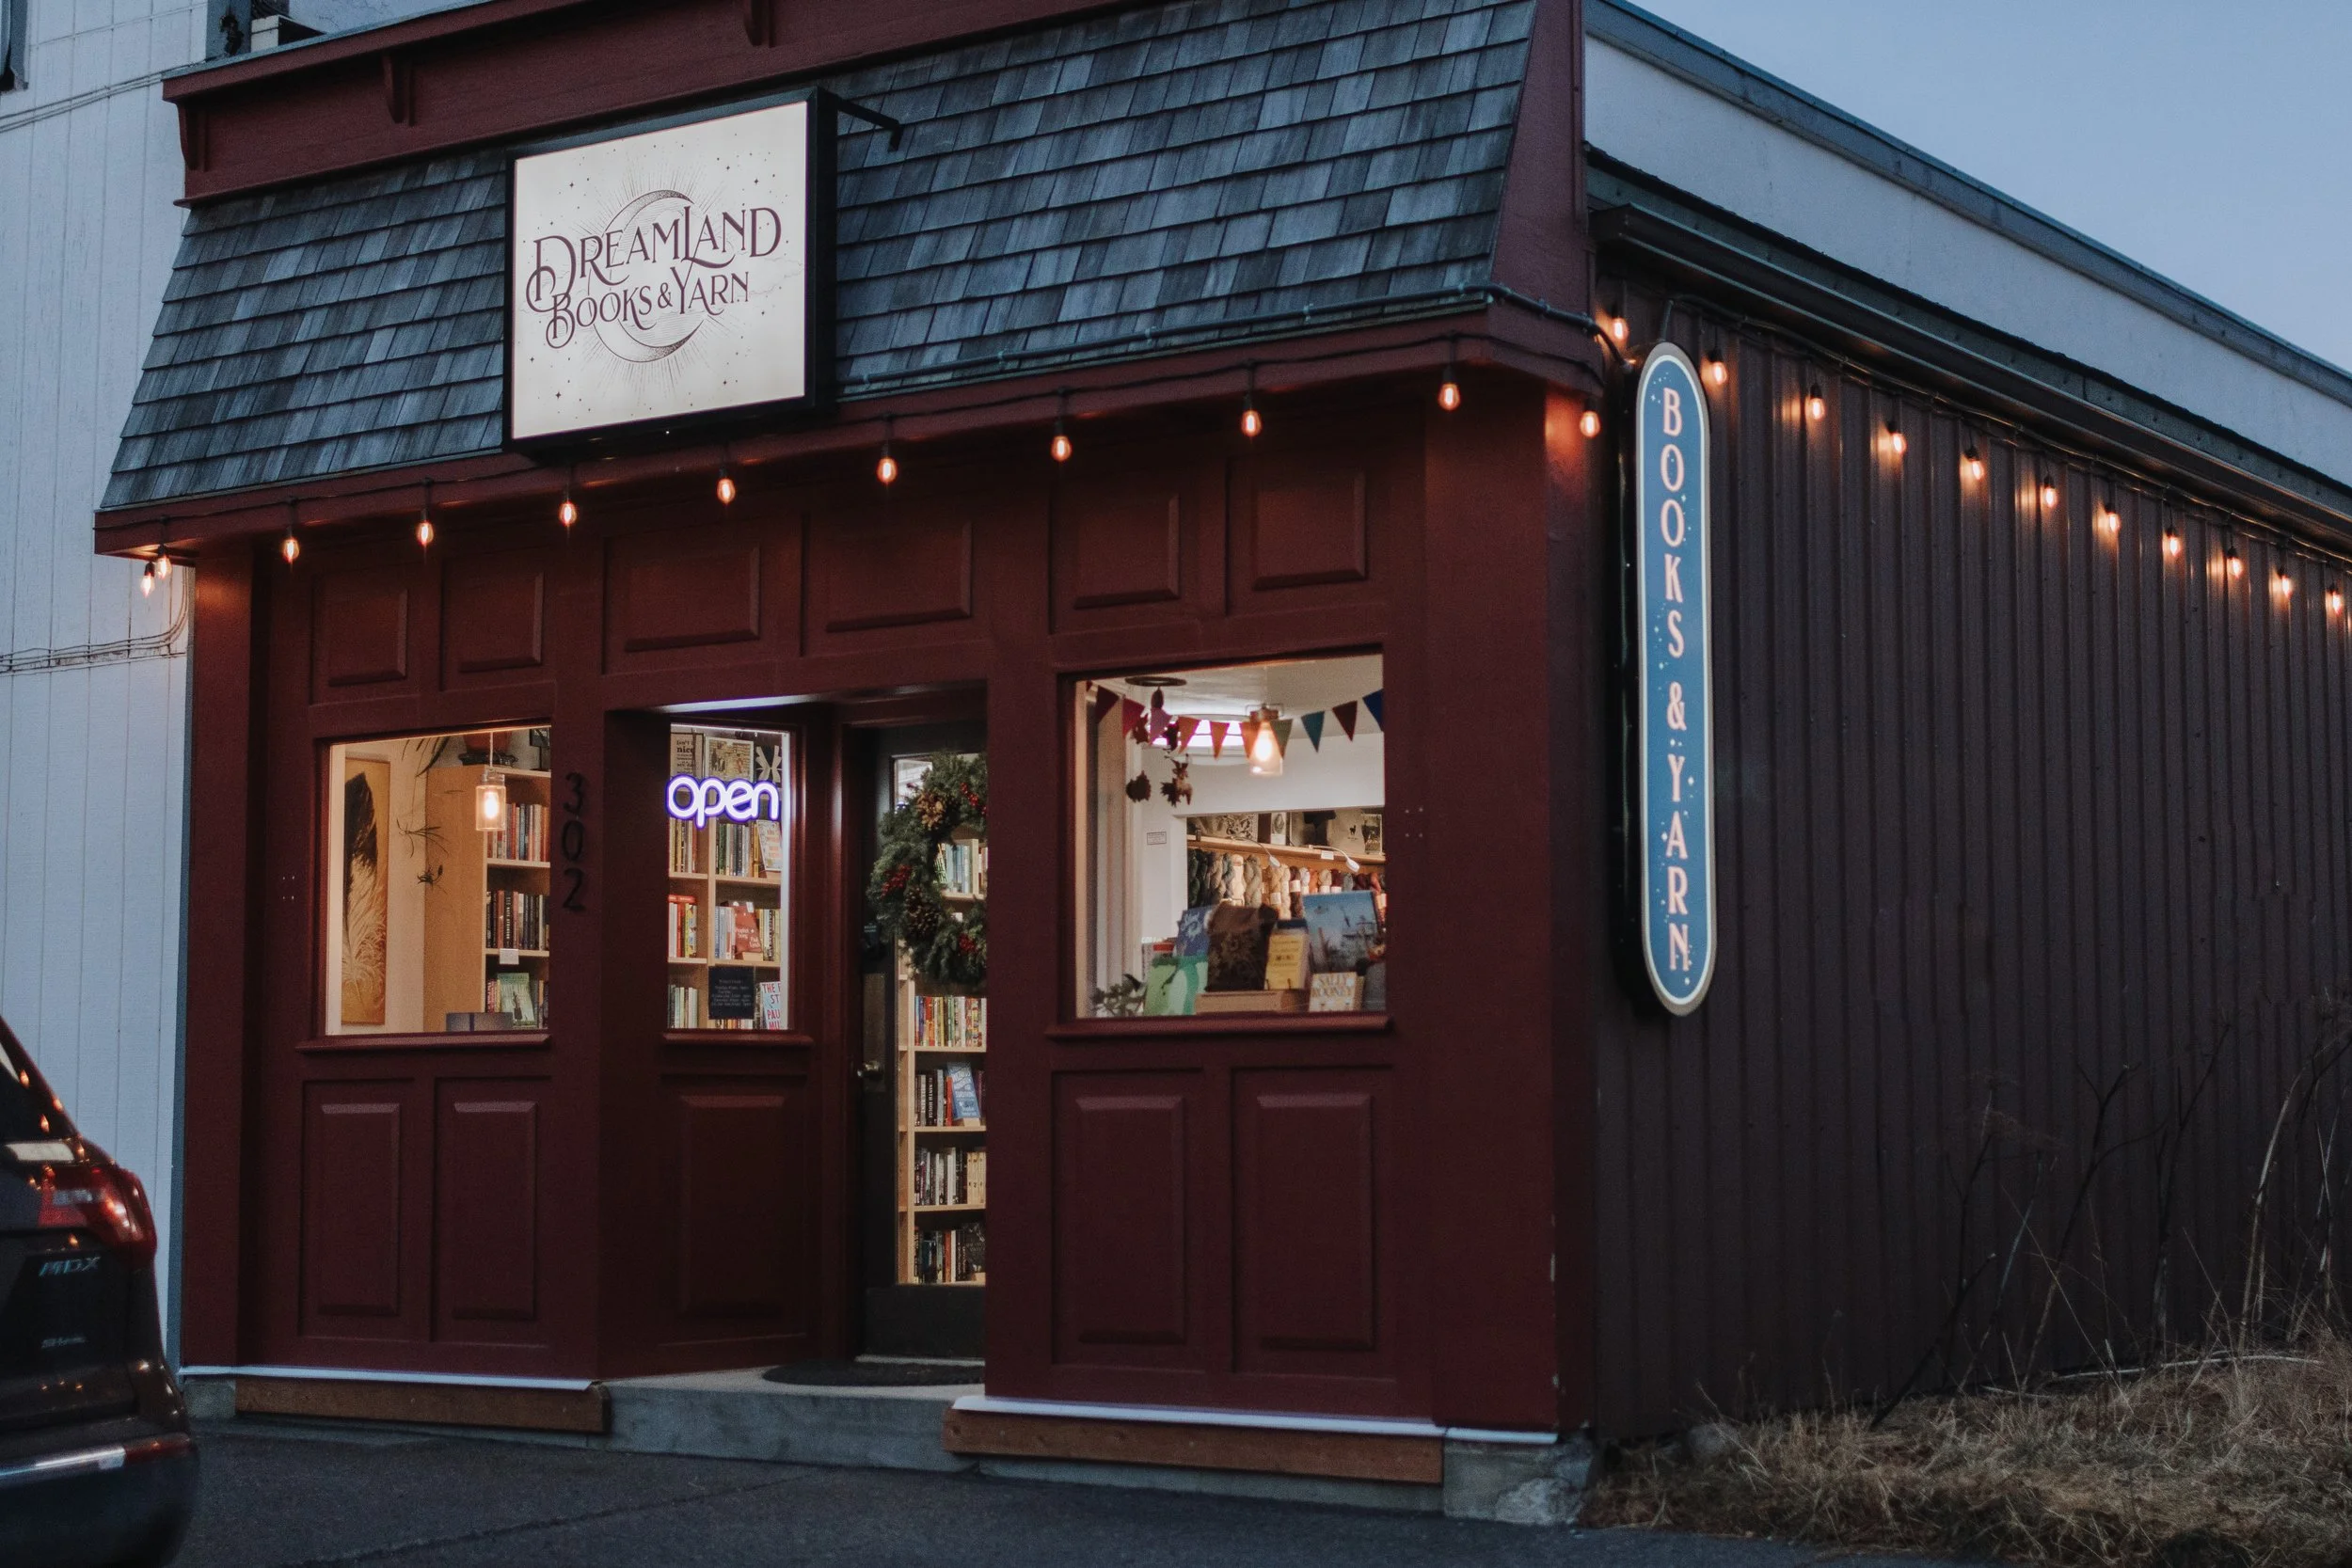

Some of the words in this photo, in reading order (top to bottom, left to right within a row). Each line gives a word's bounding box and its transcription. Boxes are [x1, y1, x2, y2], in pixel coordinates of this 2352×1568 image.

[526, 206, 783, 313] DREAMLAND
[546, 285, 658, 349] BOOKS
[657, 281, 674, 309] &
[670, 266, 750, 316] YARN
[1660, 387, 1685, 658] BOOKS
[1666, 681, 1687, 731] &
[562, 771, 585, 912] 302
[666, 775, 780, 828] open
[1665, 753, 1689, 971] YARN
[762, 983, 775, 993] THE
[39, 1256, 102, 1277] MDX
